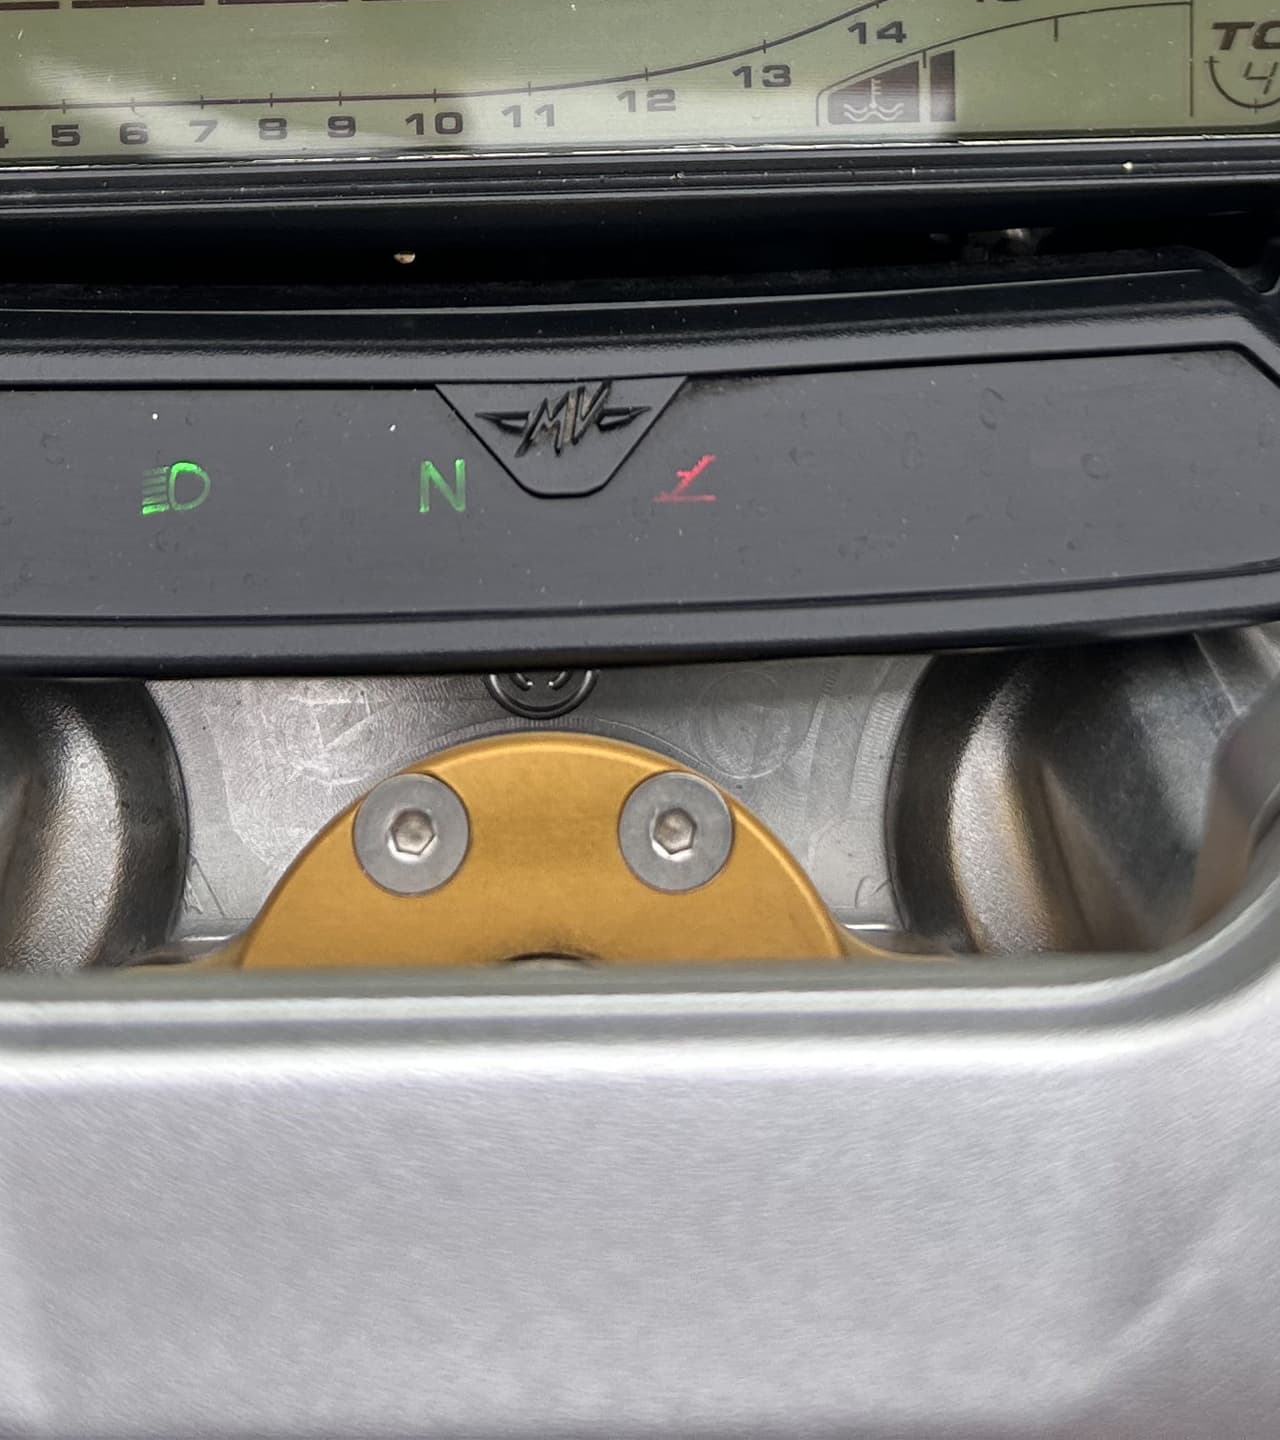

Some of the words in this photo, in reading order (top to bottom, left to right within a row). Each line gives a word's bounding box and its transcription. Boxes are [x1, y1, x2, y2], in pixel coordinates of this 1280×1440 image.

[50, 123, 81, 147] 5
[119, 121, 149, 145] 6
[190, 119, 220, 143] 7
[258, 117, 288, 141] 8
[327, 115, 357, 139] 9
[405, 112, 464, 135] 10
[501, 104, 556, 128] 11
[616, 89, 677, 113] 12
[732, 64, 792, 89] 13
[847, 21, 908, 45] 14
[1243, 61, 1279, 95] 4
[420, 458, 467, 514] N
